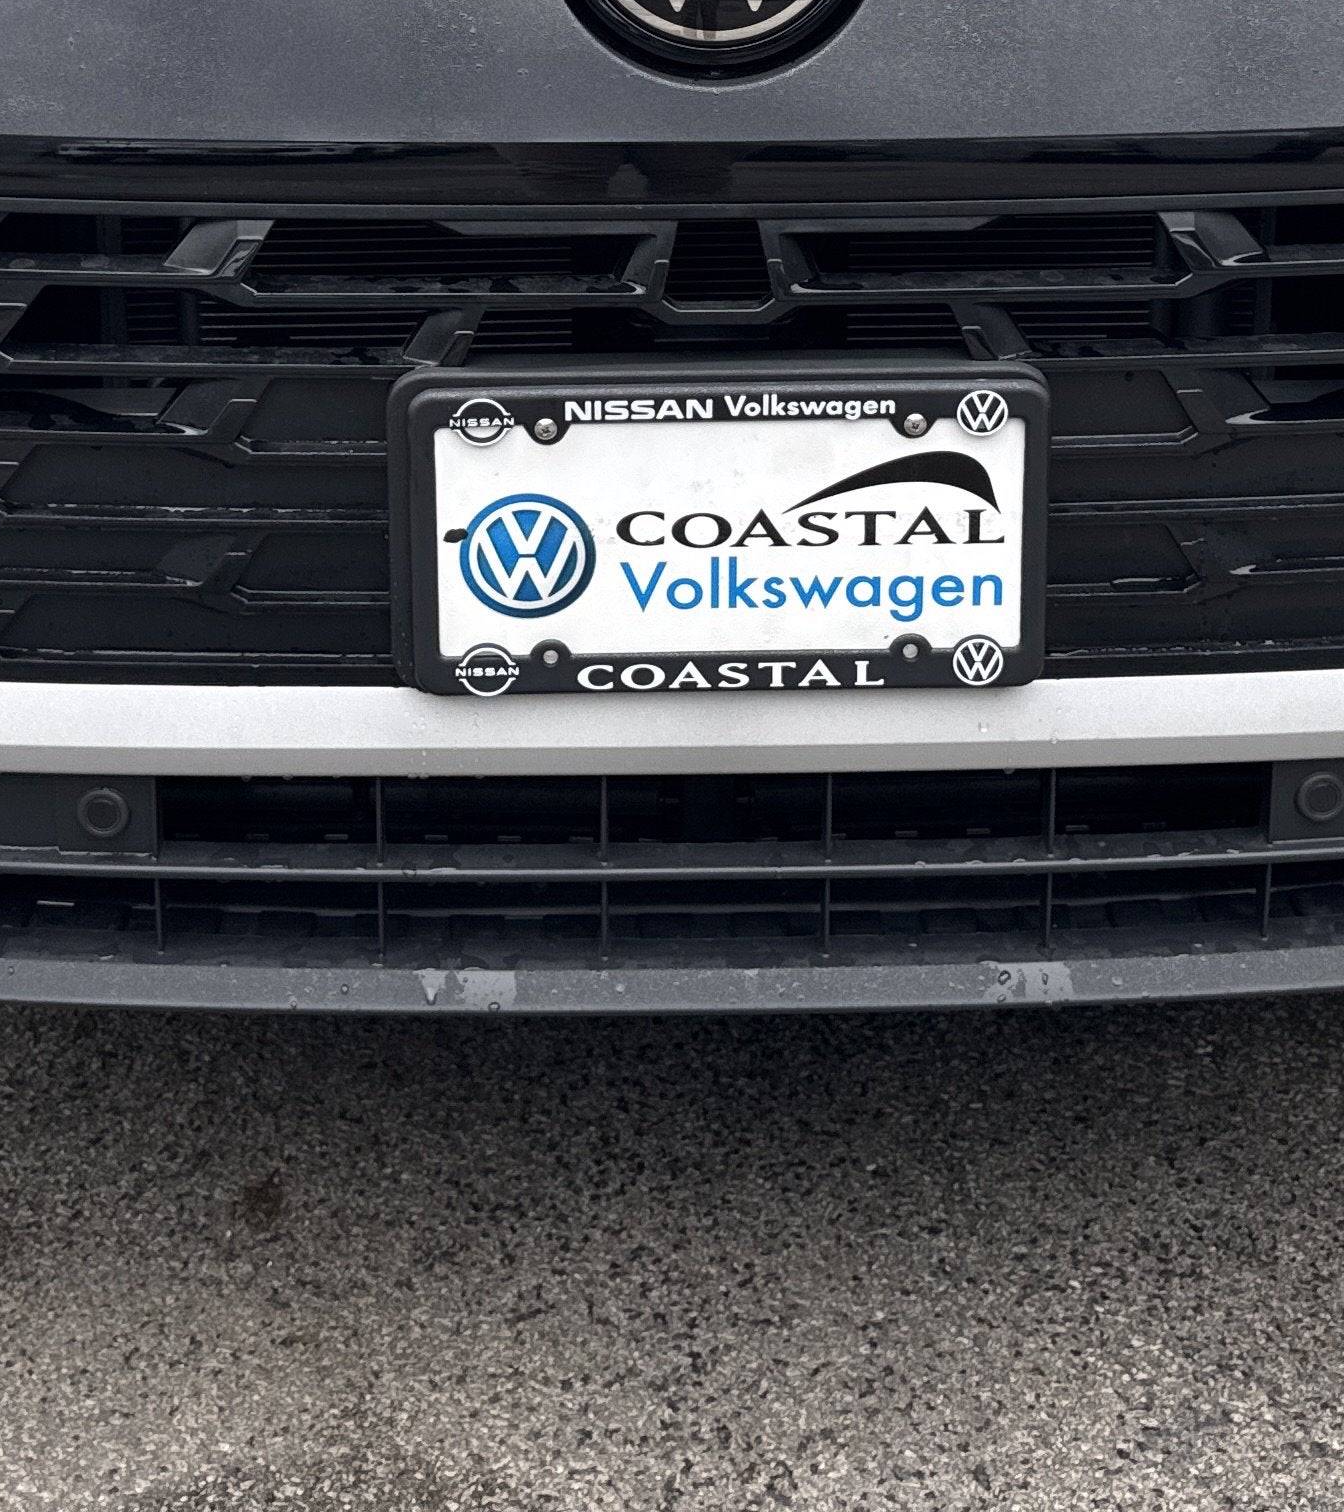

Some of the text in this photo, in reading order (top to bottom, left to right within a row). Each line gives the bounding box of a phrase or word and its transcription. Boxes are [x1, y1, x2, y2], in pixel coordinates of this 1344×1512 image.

[449, 417, 515, 428] NISSAN
[564, 393, 896, 422] NISSAN Volkswagen
[616, 506, 1005, 548] COASTAL
[619, 556, 1004, 622] Volkswagen
[455, 666, 520, 677] NISSAN
[576, 658, 885, 689] COASTAL
